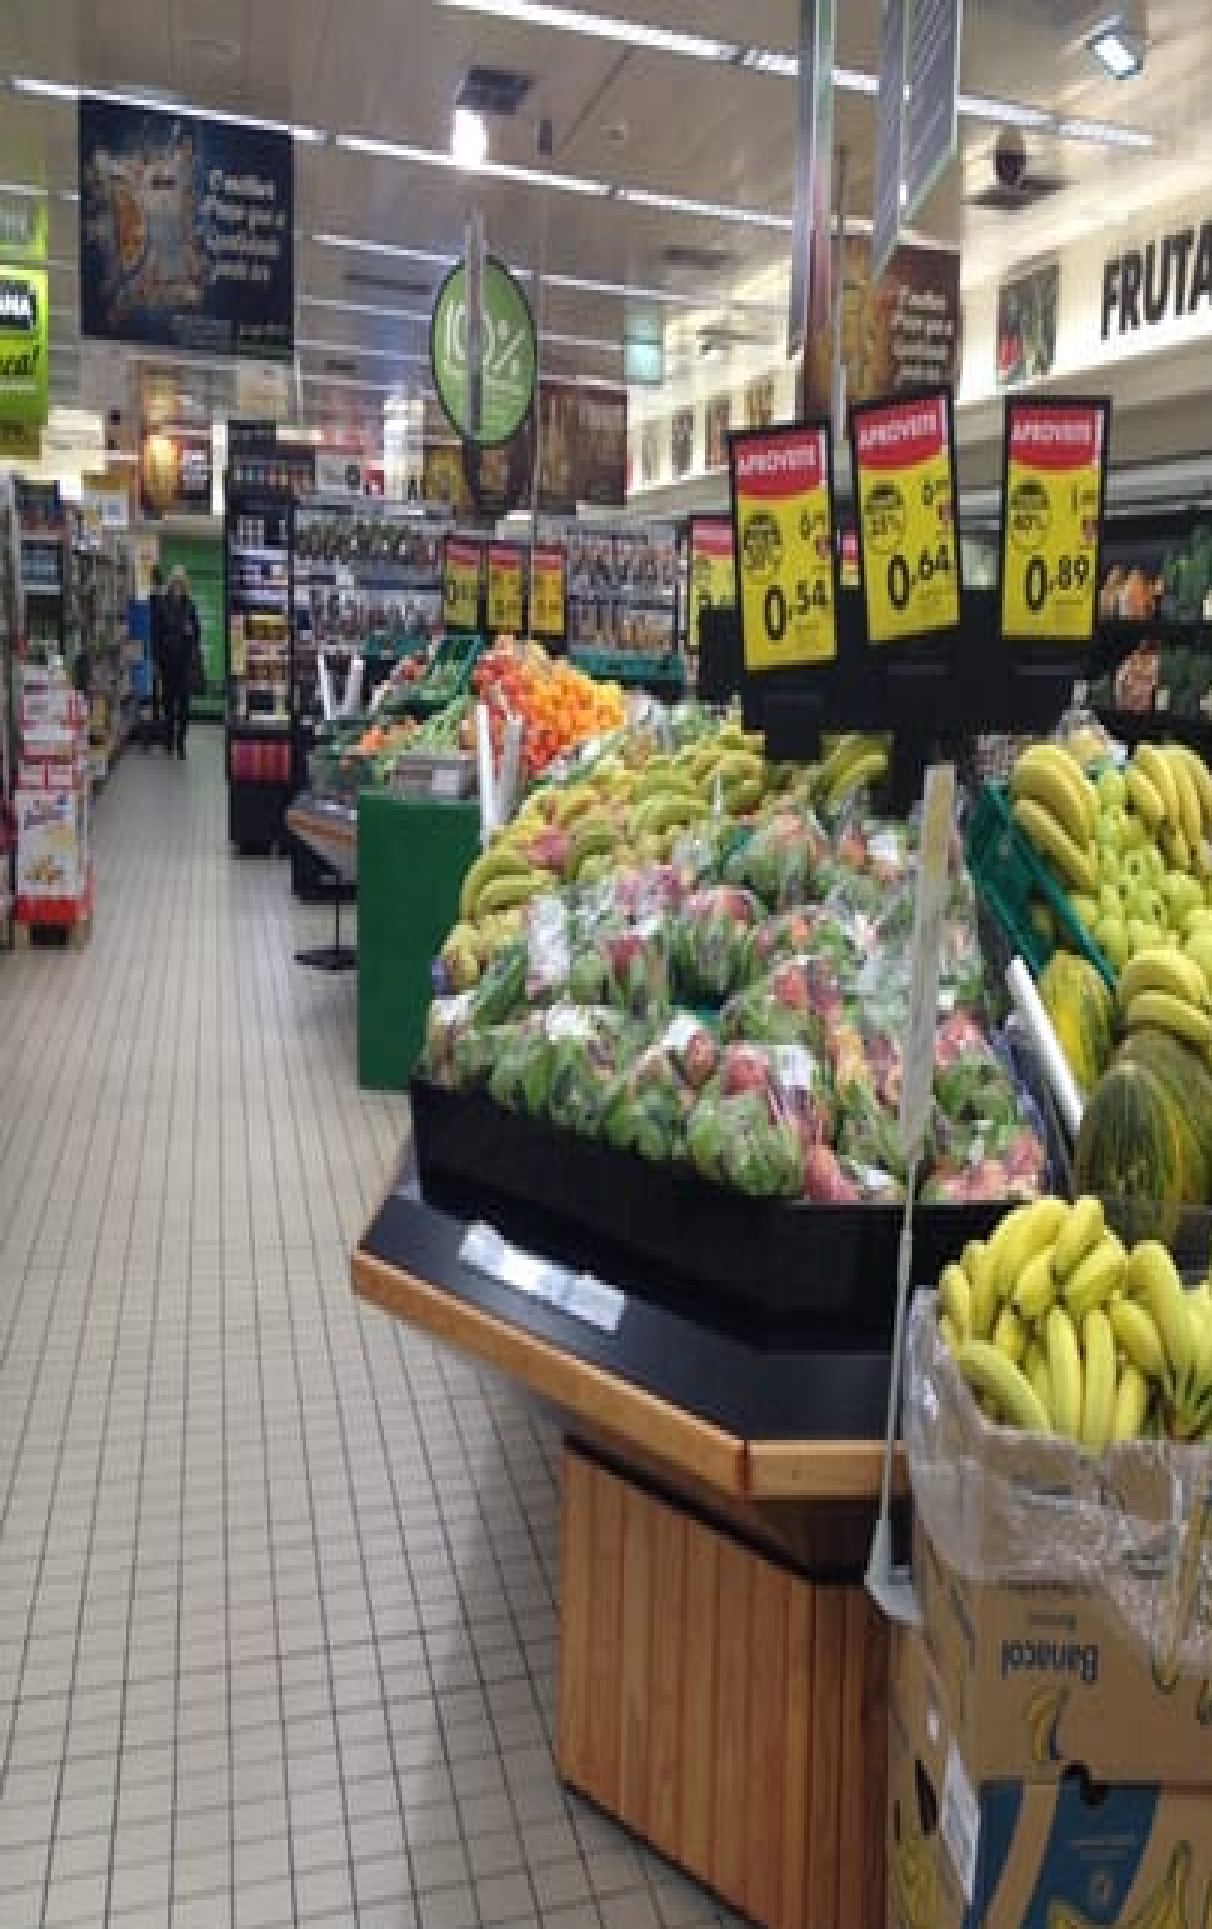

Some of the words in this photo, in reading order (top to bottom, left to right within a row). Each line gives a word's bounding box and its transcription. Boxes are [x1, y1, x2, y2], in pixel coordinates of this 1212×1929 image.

[1101, 220, 1212, 342] FRUTA
[888, 545, 951, 609] 0,64
[1025, 555, 1091, 612] 0,89
[764, 580, 829, 641] 0,54
